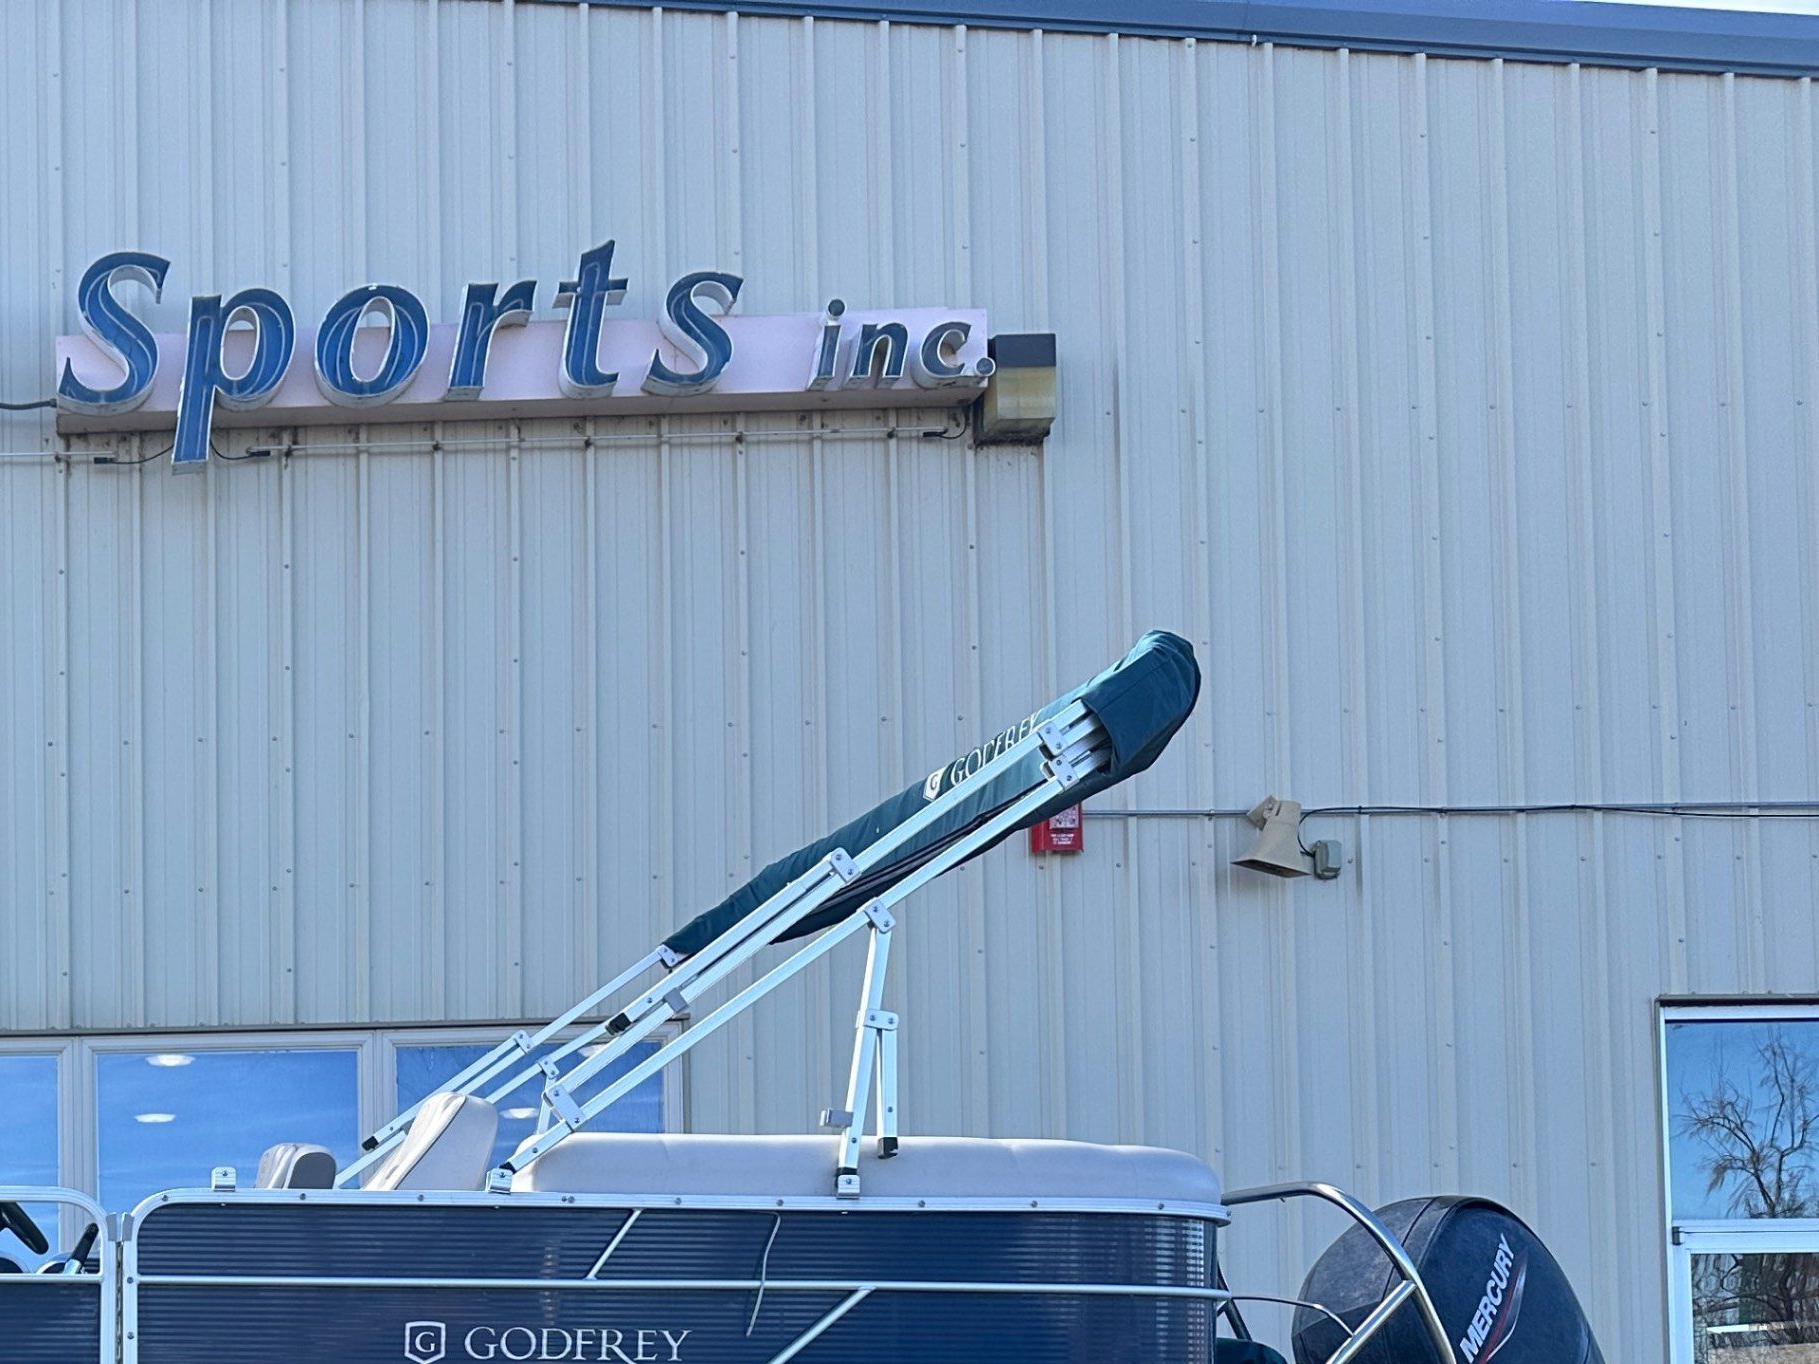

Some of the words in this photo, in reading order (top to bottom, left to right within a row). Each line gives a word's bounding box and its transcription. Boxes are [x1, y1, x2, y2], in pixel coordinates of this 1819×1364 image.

[56, 240, 744, 472] Sports
[809, 298, 996, 390] inc.
[1459, 1232, 1514, 1364] MERCURY
